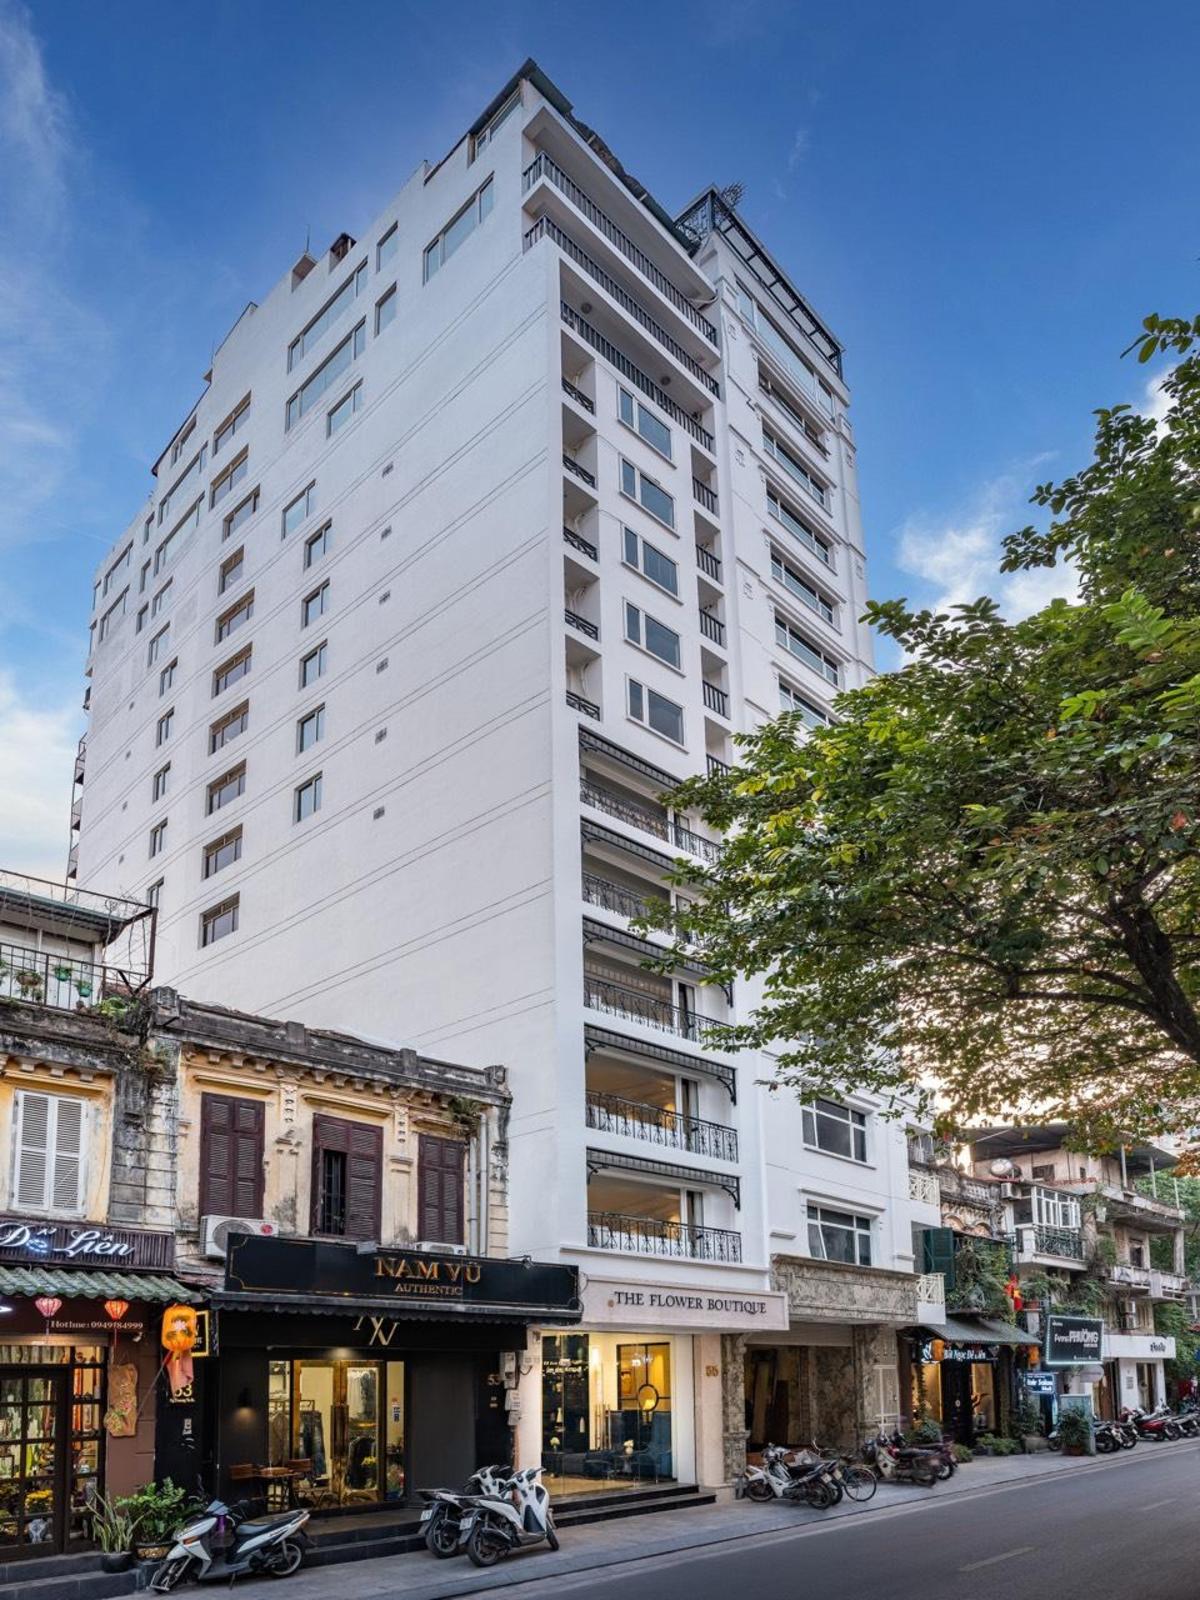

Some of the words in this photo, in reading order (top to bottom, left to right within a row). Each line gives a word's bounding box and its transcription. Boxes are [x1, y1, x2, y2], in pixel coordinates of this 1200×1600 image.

[53, 1230, 135, 1257] Liên
[374, 1257, 440, 1280] NAM
[394, 1283, 463, 1296] AUTHENTIC
[614, 1291, 644, 1306] THE
[650, 1294, 703, 1310] FLOWER
[707, 1299, 767, 1315] BOUTIQUE
